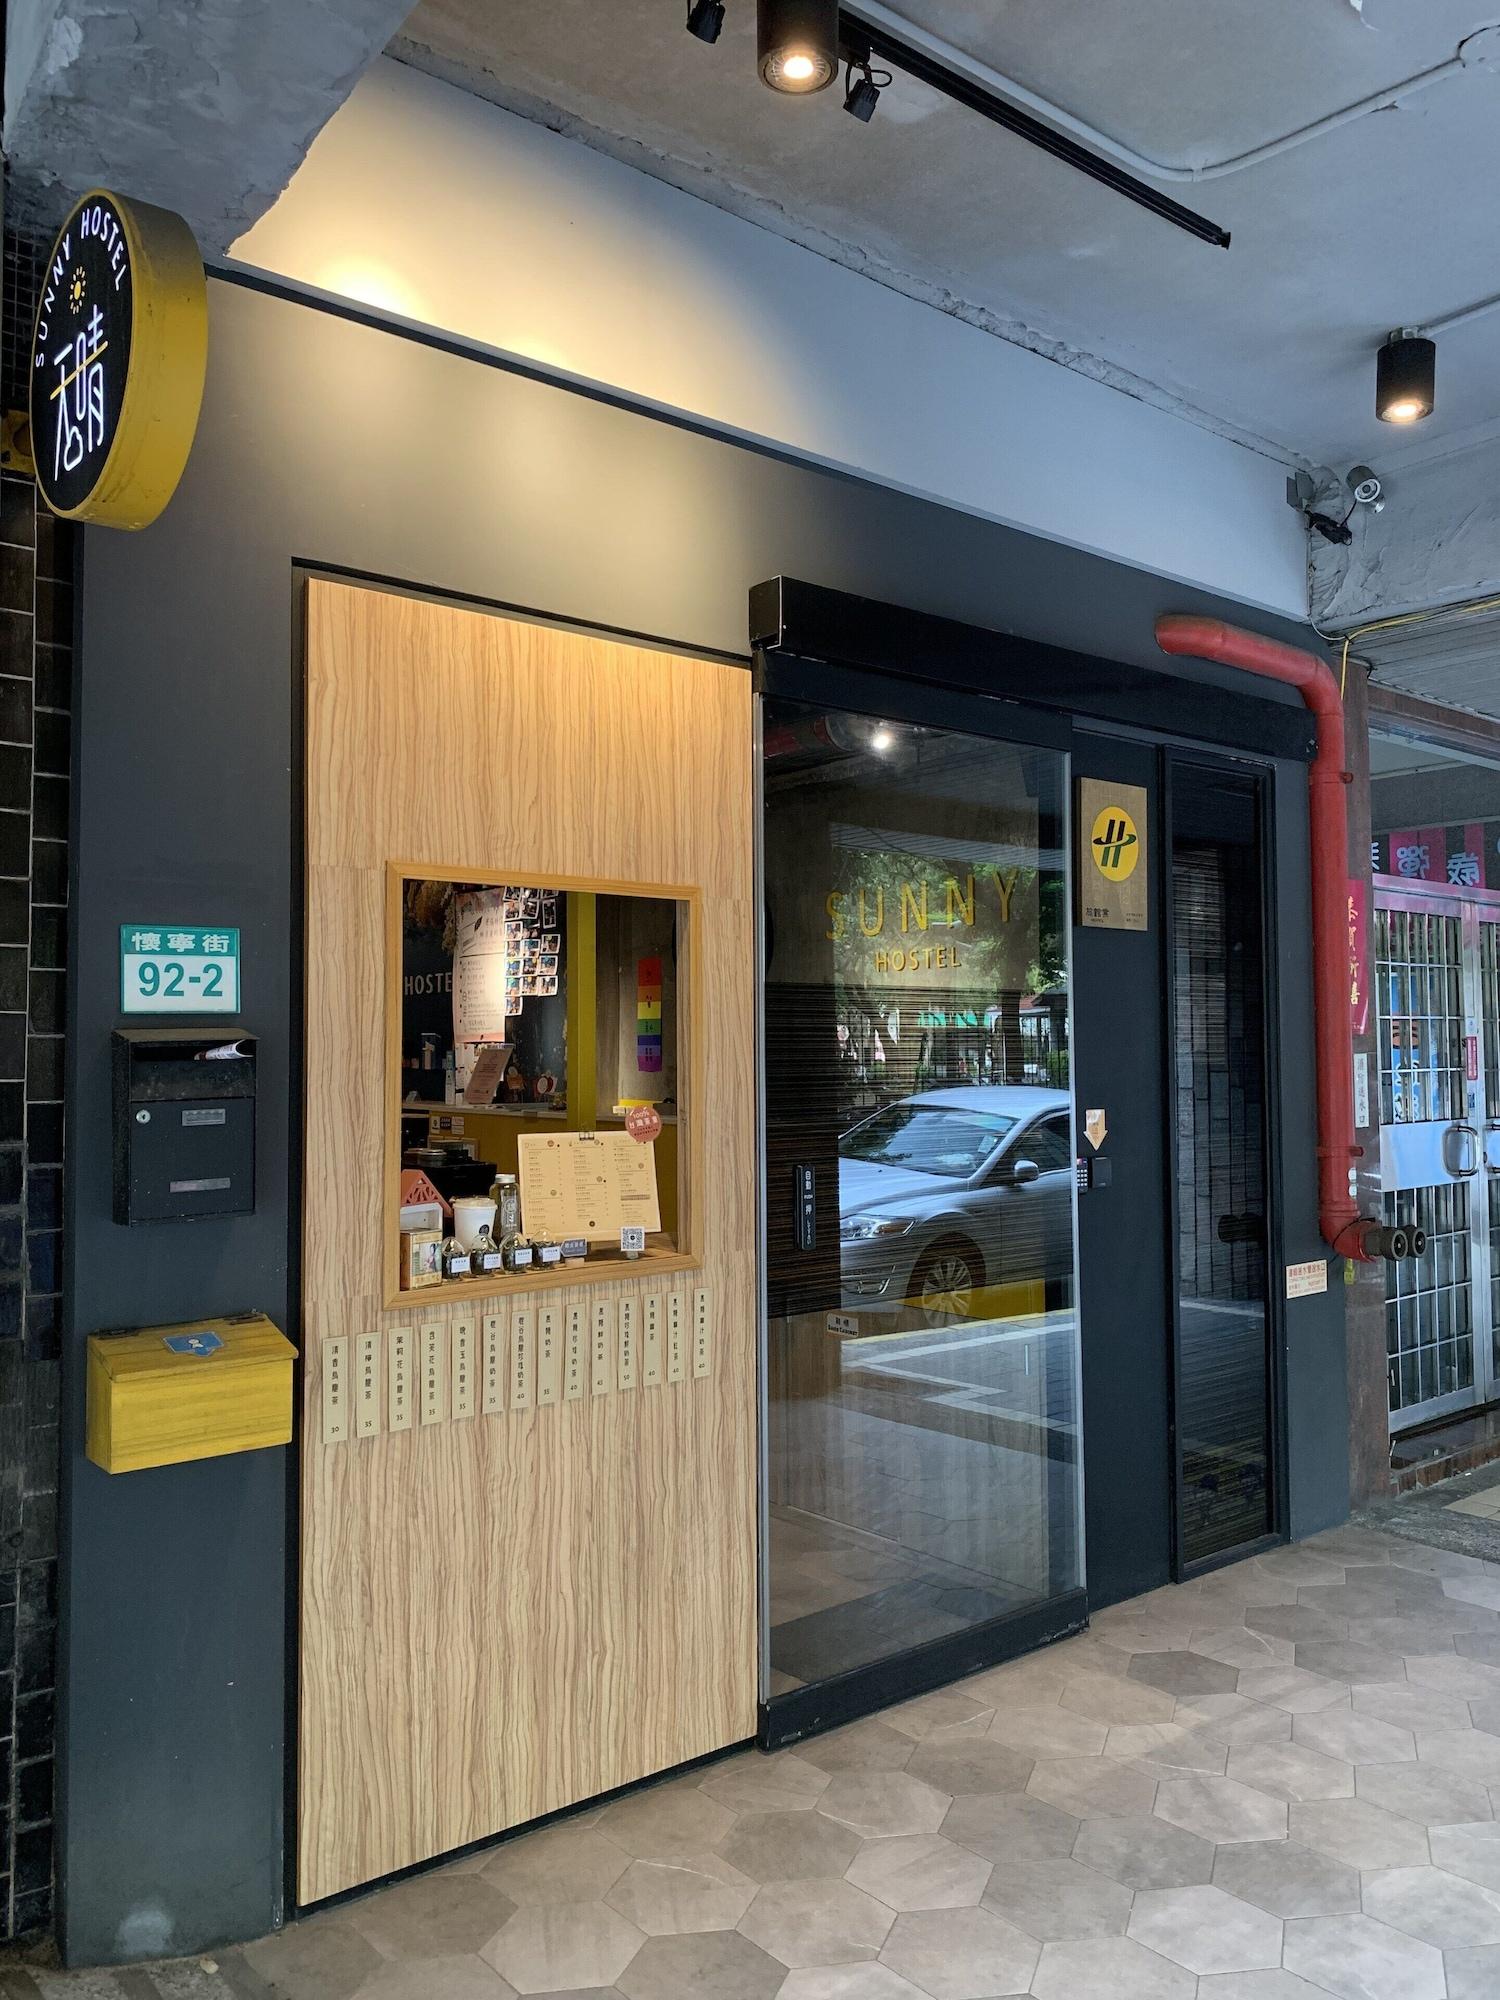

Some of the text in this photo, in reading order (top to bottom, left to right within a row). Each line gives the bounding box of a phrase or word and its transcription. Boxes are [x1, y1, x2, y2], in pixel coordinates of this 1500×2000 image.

[36, 205, 130, 368] SUNNY HOSTEL
[825, 869, 1020, 941] SUNNY
[131, 931, 230, 953] 懷寧街
[874, 946, 963, 973] HOSTEL
[138, 961, 224, 997] 92-2
[570, 1384, 578, 1392] 40
[517, 1392, 525, 1400] 40
[428, 1408, 435, 1416] 35
[459, 1402, 466, 1410] 35
[364, 1420, 372, 1428] 35
